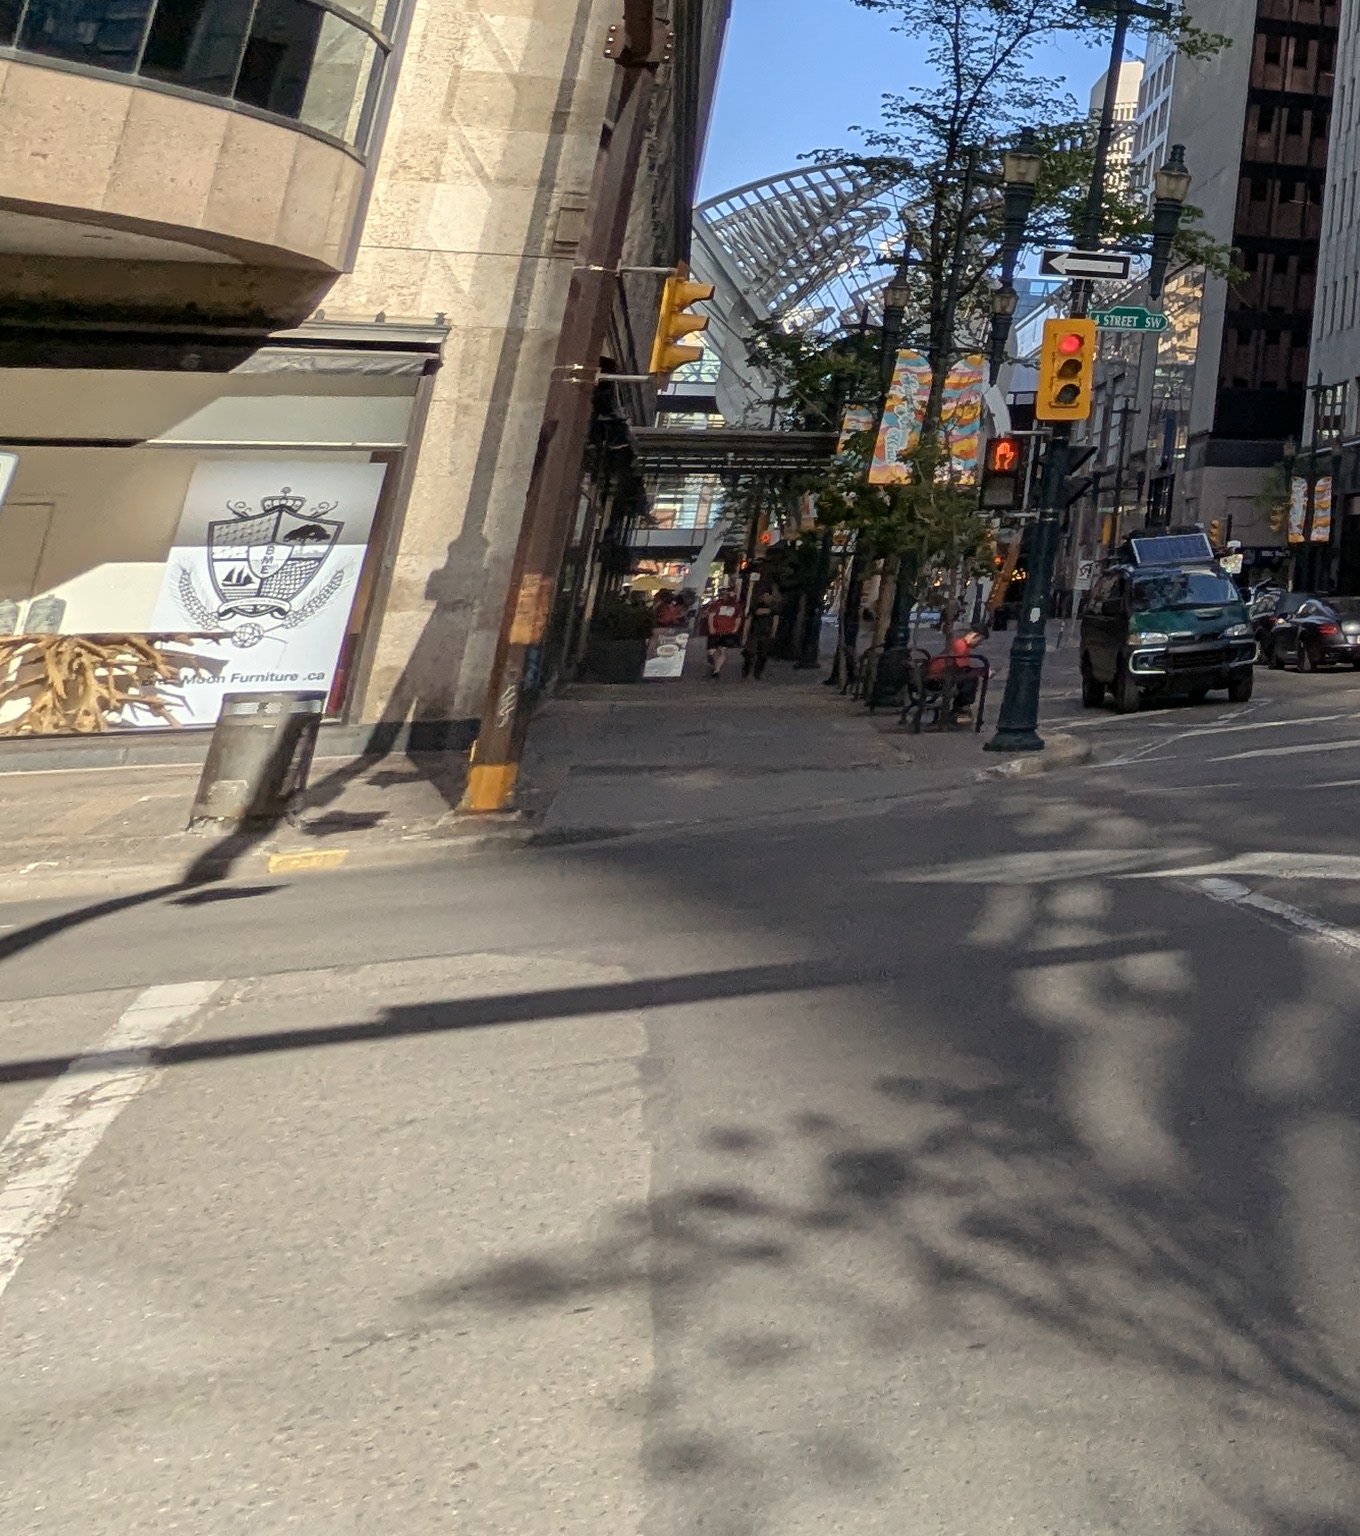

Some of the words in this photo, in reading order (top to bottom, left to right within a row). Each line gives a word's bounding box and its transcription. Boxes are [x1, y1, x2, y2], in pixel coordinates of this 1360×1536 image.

[1103, 315, 1139, 328] STREET
[1145, 316, 1162, 328] SW
[231, 671, 299, 684] Furniture
